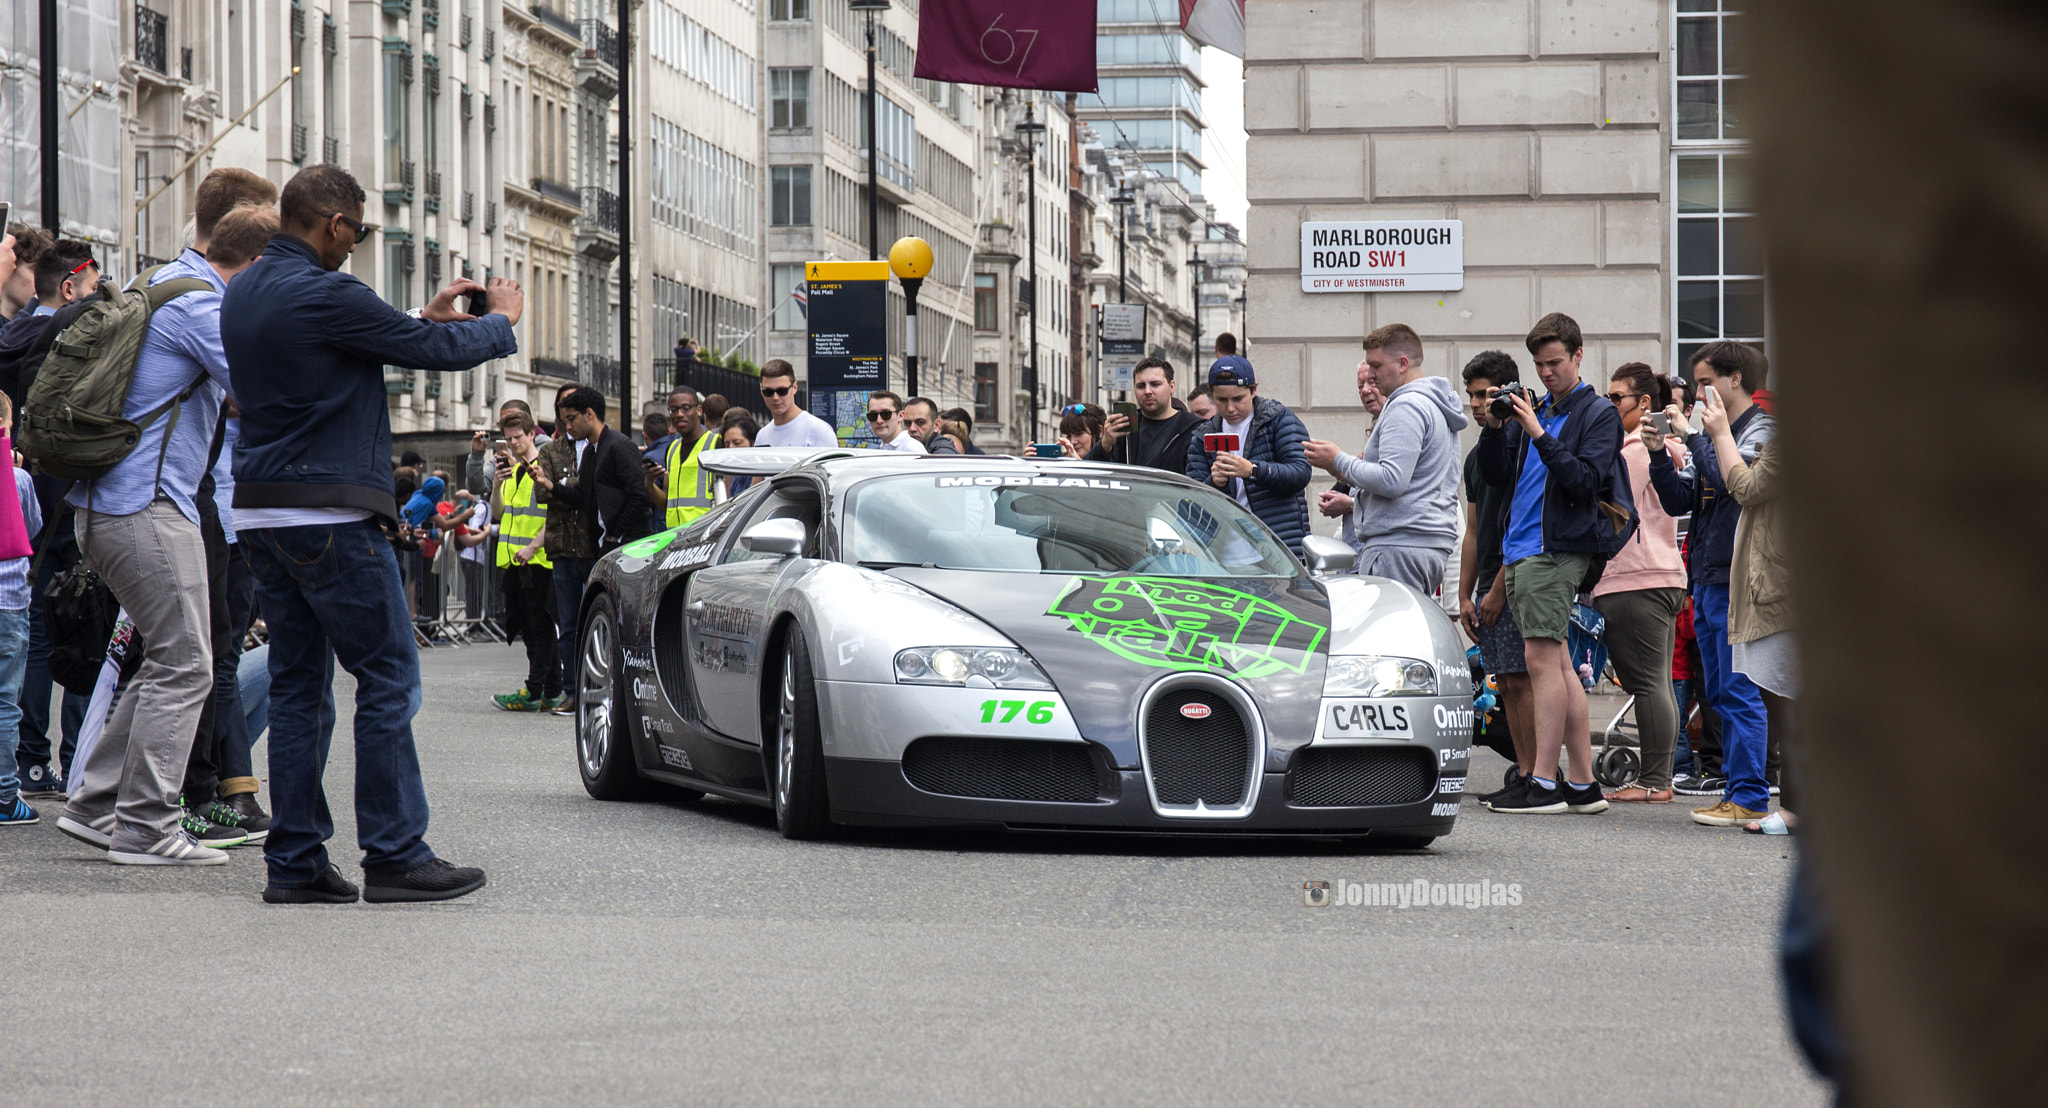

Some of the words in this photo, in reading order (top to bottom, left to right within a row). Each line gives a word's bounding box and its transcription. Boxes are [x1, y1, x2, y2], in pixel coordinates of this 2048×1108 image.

[979, 13, 1039, 78] 67
[1313, 228, 1451, 246] MARLBOROUGH
[1313, 251, 1361, 268] ROAD
[1368, 250, 1406, 267] SW1
[1313, 279, 1331, 288] CITY
[1333, 279, 1344, 287] OF
[1347, 278, 1405, 287] WESTMINSTER
[939, 476, 1130, 490] MODBALL
[658, 542, 717, 570] MODBALL
[633, 677, 657, 701] Ontime
[980, 700, 1056, 724] 176
[1332, 705, 1408, 730] C4RLS
[1433, 703, 1474, 728] Ontim
[1451, 747, 1471, 760] SmarT
[1431, 802, 1460, 817] MODB
